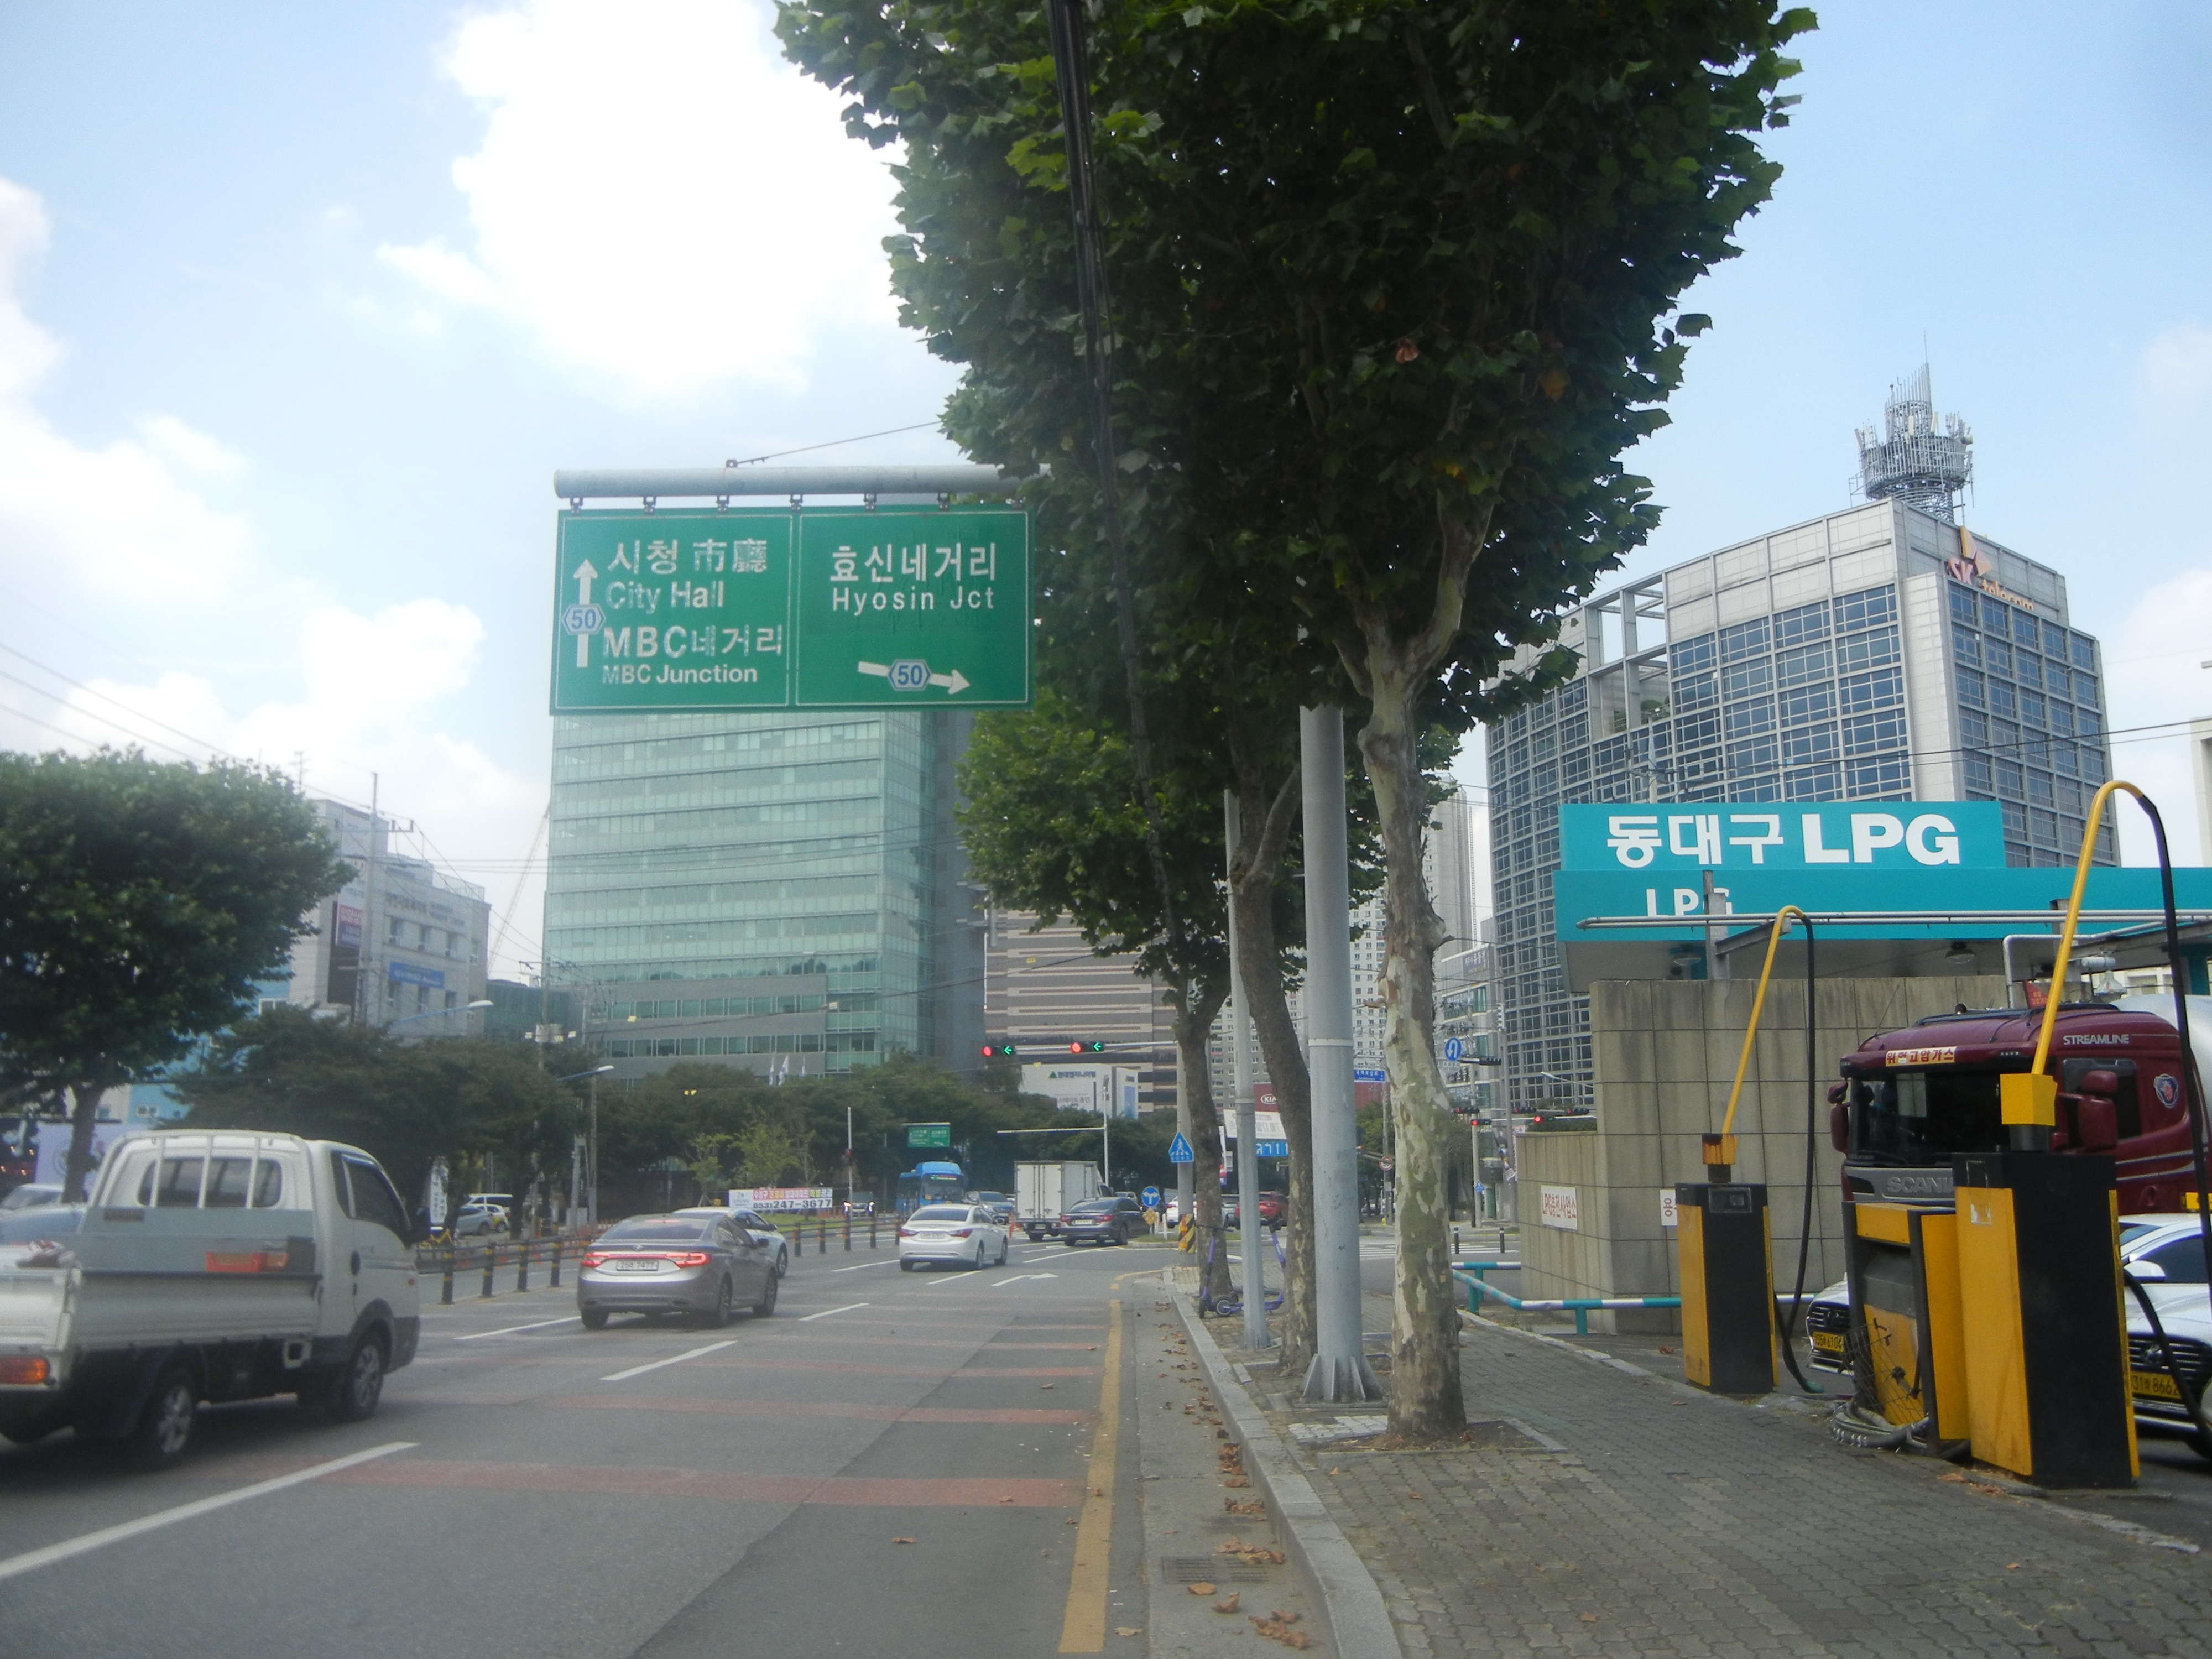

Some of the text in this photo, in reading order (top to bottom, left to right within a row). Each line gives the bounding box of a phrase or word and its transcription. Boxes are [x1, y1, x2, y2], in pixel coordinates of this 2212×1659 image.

[607, 538, 768, 575] 시청 市廳
[830, 542, 995, 583] 효신네거리
[606, 580, 724, 614] City Hall
[832, 586, 994, 616] Hyosin Jct
[1948, 557, 2034, 612] SK telecom
[571, 609, 596, 629] 50
[603, 624, 782, 659] MBC네거리
[602, 664, 758, 684] MBC Junction
[897, 665, 922, 685] 50
[1606, 812, 1960, 869] 동대구 LPG
[2063, 1034, 2130, 1045] STREAMLINE
